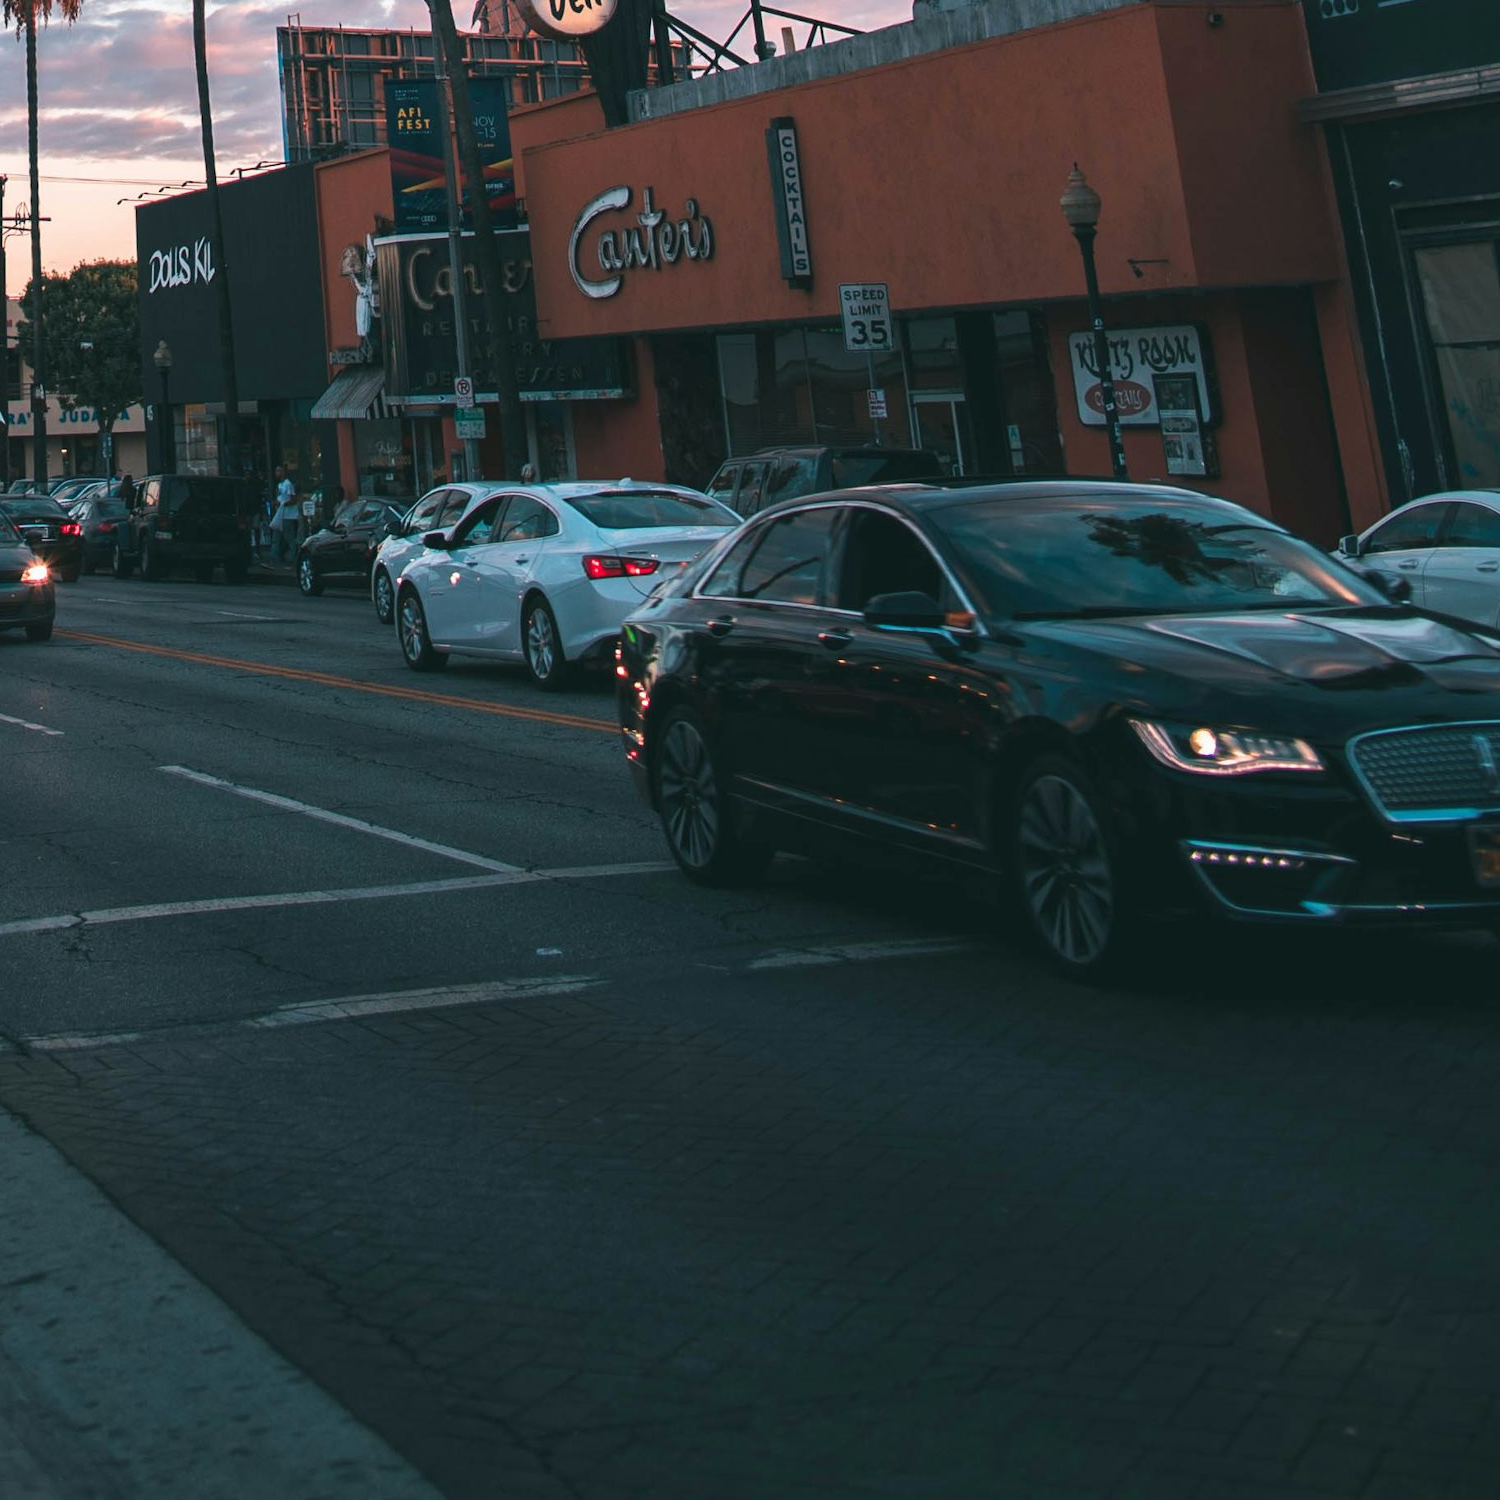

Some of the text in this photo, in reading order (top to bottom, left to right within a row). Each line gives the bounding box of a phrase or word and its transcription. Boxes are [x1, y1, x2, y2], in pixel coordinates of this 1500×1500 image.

[397, 106, 421, 118] AFI
[397, 119, 431, 130] FEST
[781, 136, 807, 271] COCKTAILS
[568, 184, 711, 299] Canter's
[148, 236, 216, 294] DOLLS KIL
[843, 289, 885, 302] SPEED
[849, 305, 882, 316] LIMIT
[850, 320, 888, 345] 35
